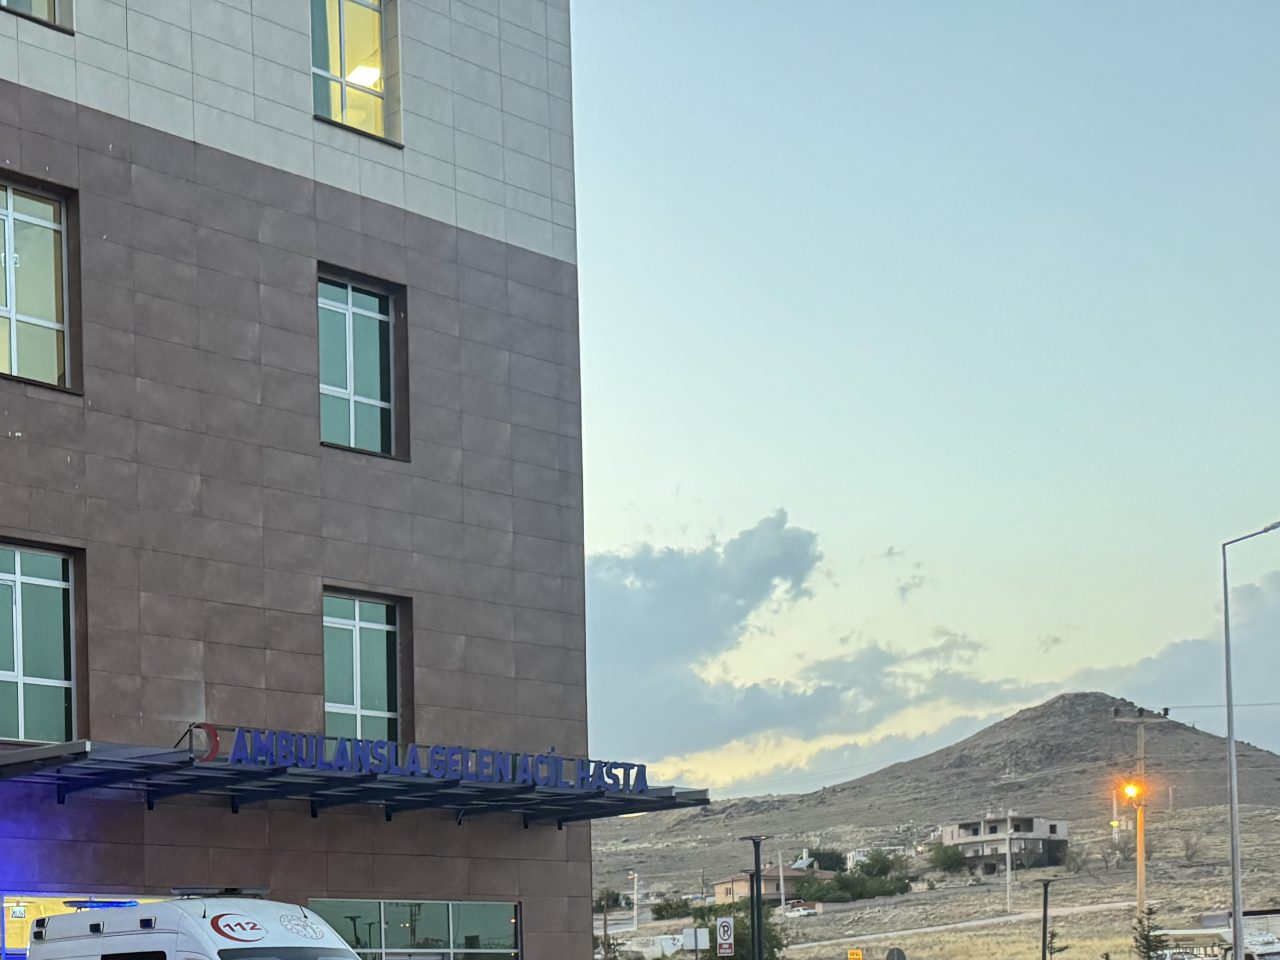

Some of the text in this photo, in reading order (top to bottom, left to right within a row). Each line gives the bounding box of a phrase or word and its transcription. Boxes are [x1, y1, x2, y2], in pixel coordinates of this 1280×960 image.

[228, 727, 650, 794] AMBULANSLA GELEN ACİL HASTA
[223, 921, 262, 932] 112
